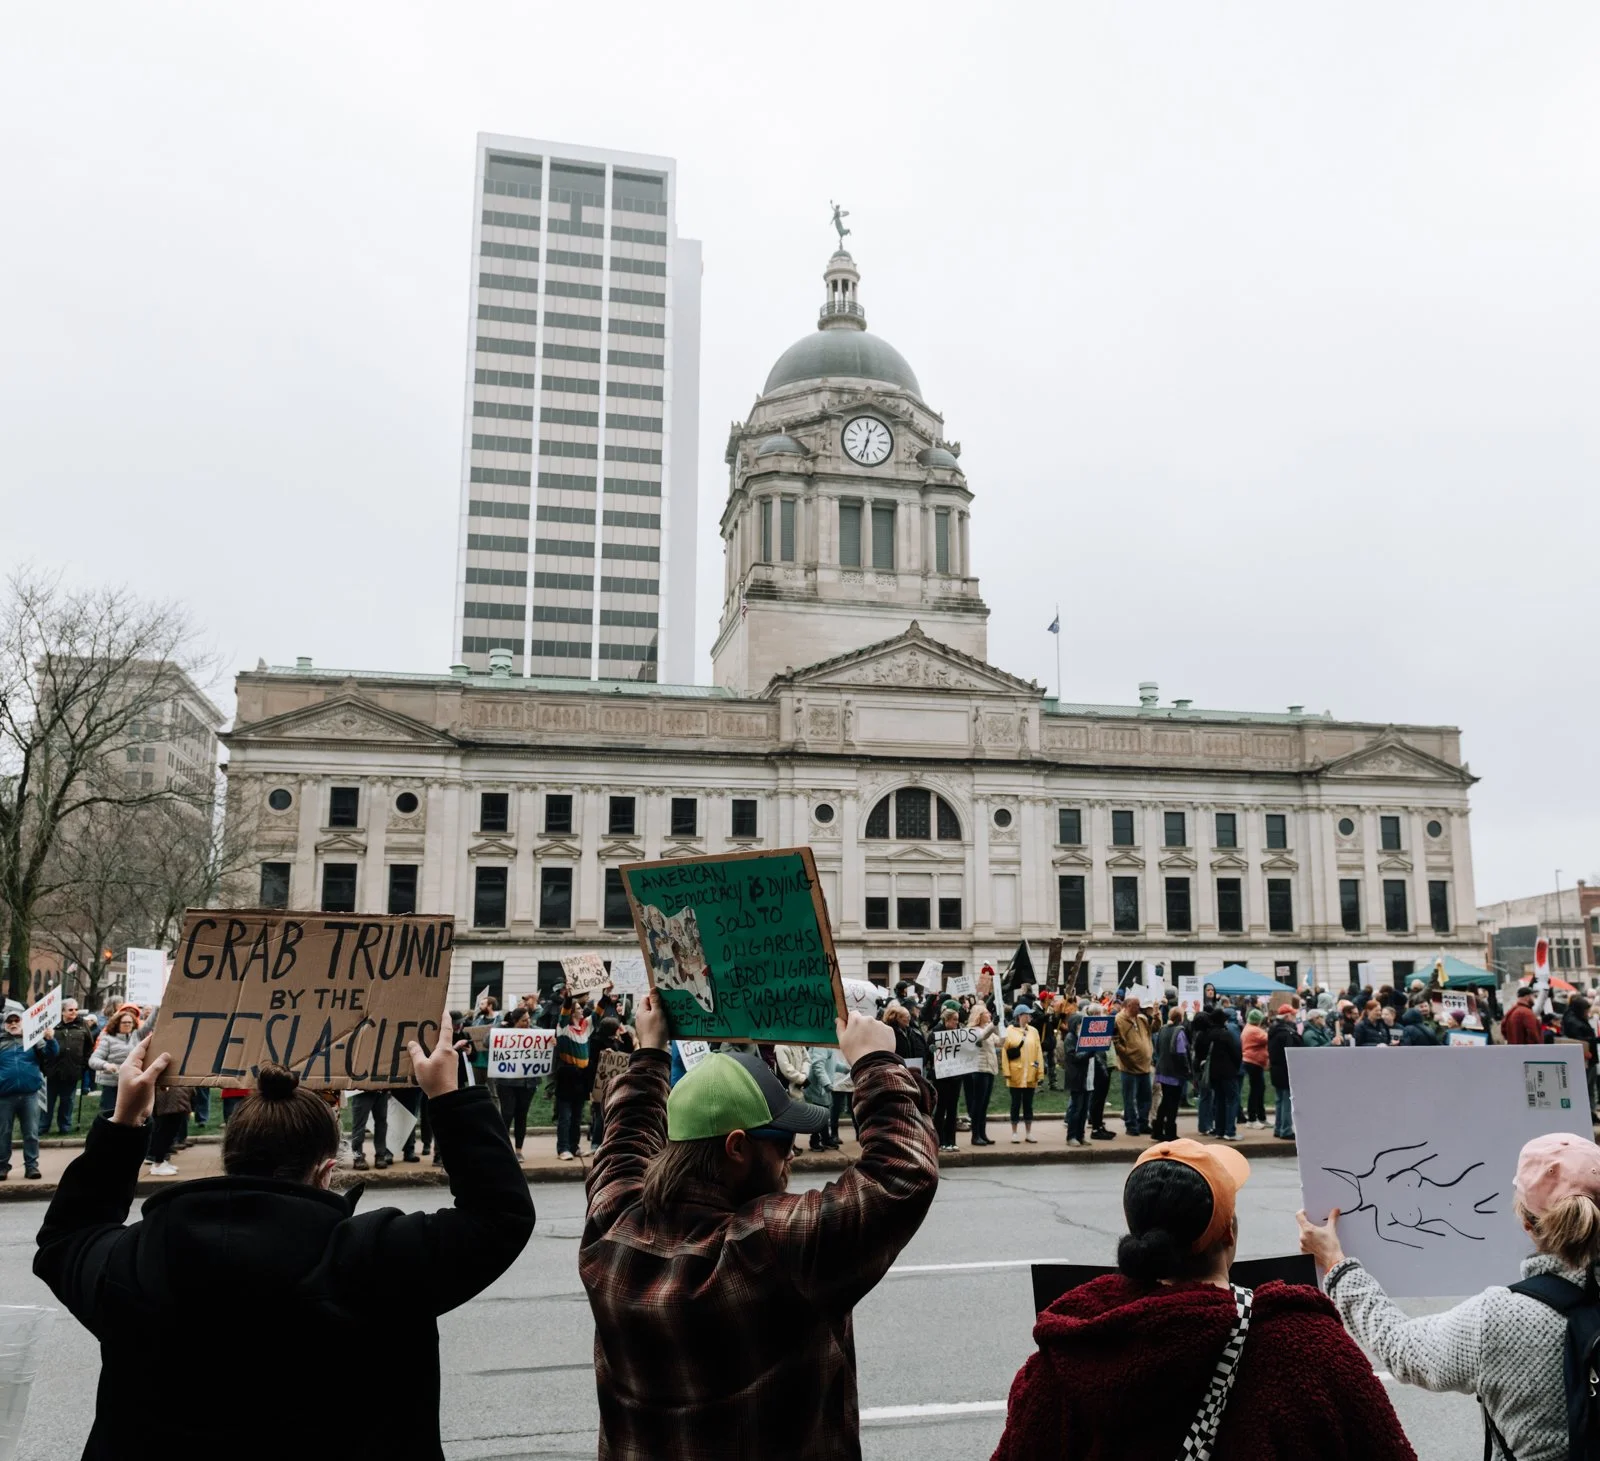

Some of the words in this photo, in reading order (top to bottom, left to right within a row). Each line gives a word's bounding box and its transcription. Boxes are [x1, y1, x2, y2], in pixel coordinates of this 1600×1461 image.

[640, 864, 726, 891] AMERICAN
[662, 880, 742, 912] DEMOCRACY
[715, 912, 756, 937] SOLD
[757, 906, 783, 924] TO
[183, 918, 303, 983] GRAB
[324, 921, 454, 981] TRUMP
[723, 929, 817, 962] OLIGARCHS
[270, 989, 306, 1010] BY
[314, 988, 365, 1010] THE
[718, 983, 828, 1013] REPUBLICANS
[750, 1006, 802, 1030] WAKE
[1088, 1020, 1108, 1033] SAVE
[493, 1035, 552, 1049] HISTORY
[935, 1028, 977, 1046] HANDS
[493, 1050, 511, 1061] HAS
[513, 1050, 531, 1060] ITS
[534, 1050, 552, 1060] EYE
[936, 1045, 961, 1061] OFF
[498, 1062, 516, 1073] ON
[522, 1062, 551, 1076] YOU
